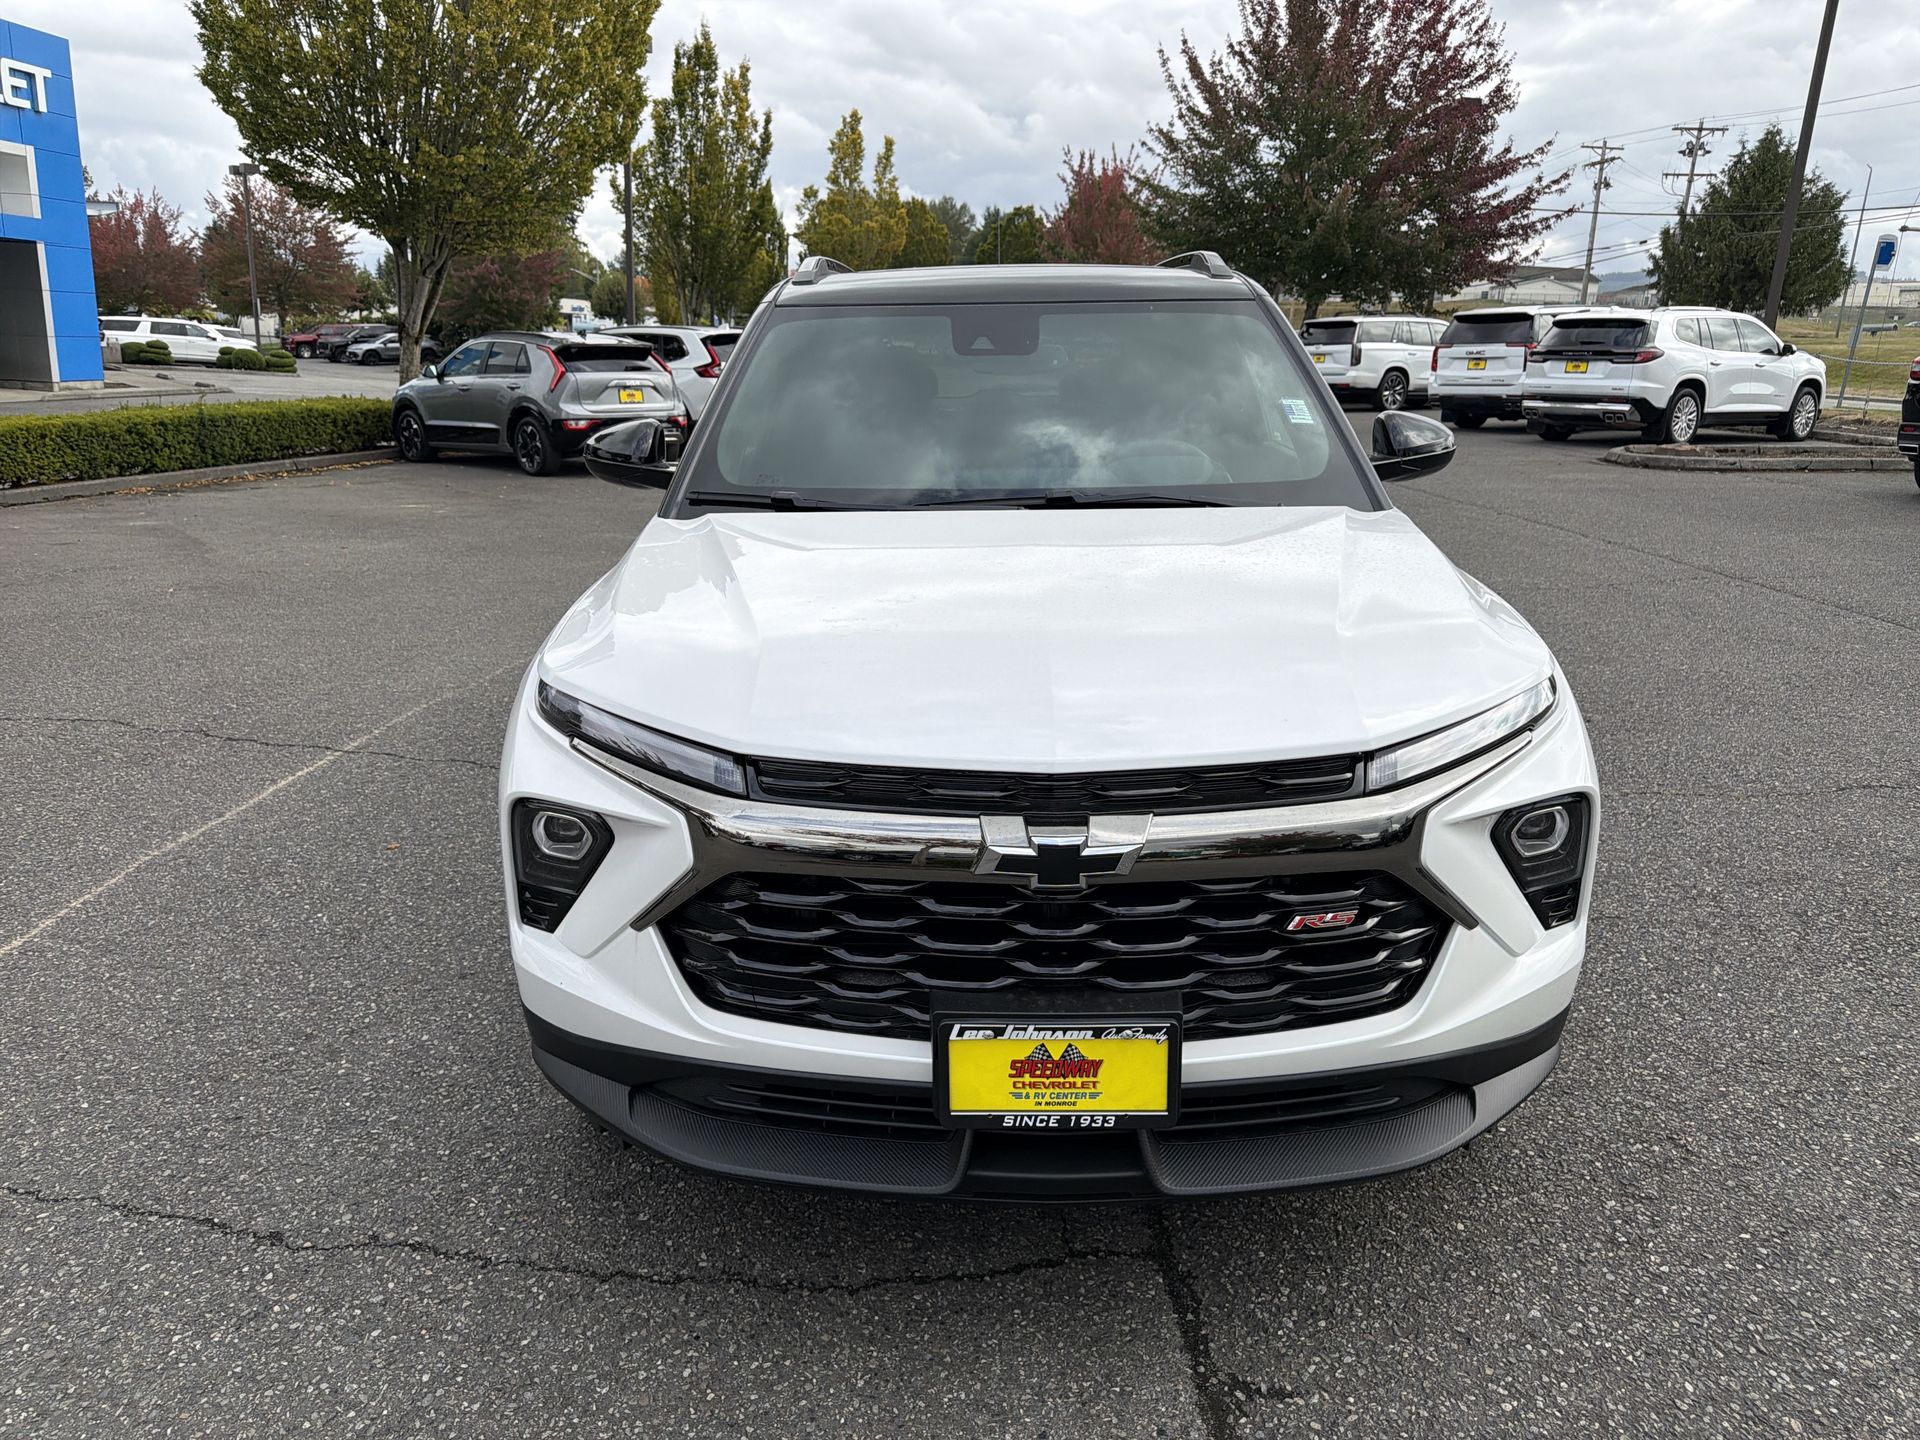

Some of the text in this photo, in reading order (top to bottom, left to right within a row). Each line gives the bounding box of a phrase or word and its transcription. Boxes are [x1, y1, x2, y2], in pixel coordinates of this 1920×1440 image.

[0, 57, 52, 113] ET
[1286, 909, 1359, 931] RS
[996, 1024, 1096, 1040] Johnson
[1101, 1028, 1134, 1040] Aut
[1131, 1027, 1169, 1044] Family
[1008, 1059, 1104, 1079] SPEEDWAY
[1012, 1081, 1100, 1090] CHEVROLET
[1023, 1091, 1087, 1100] & RV CENTER
[1002, 1116, 1115, 1127] SINCE 1933
